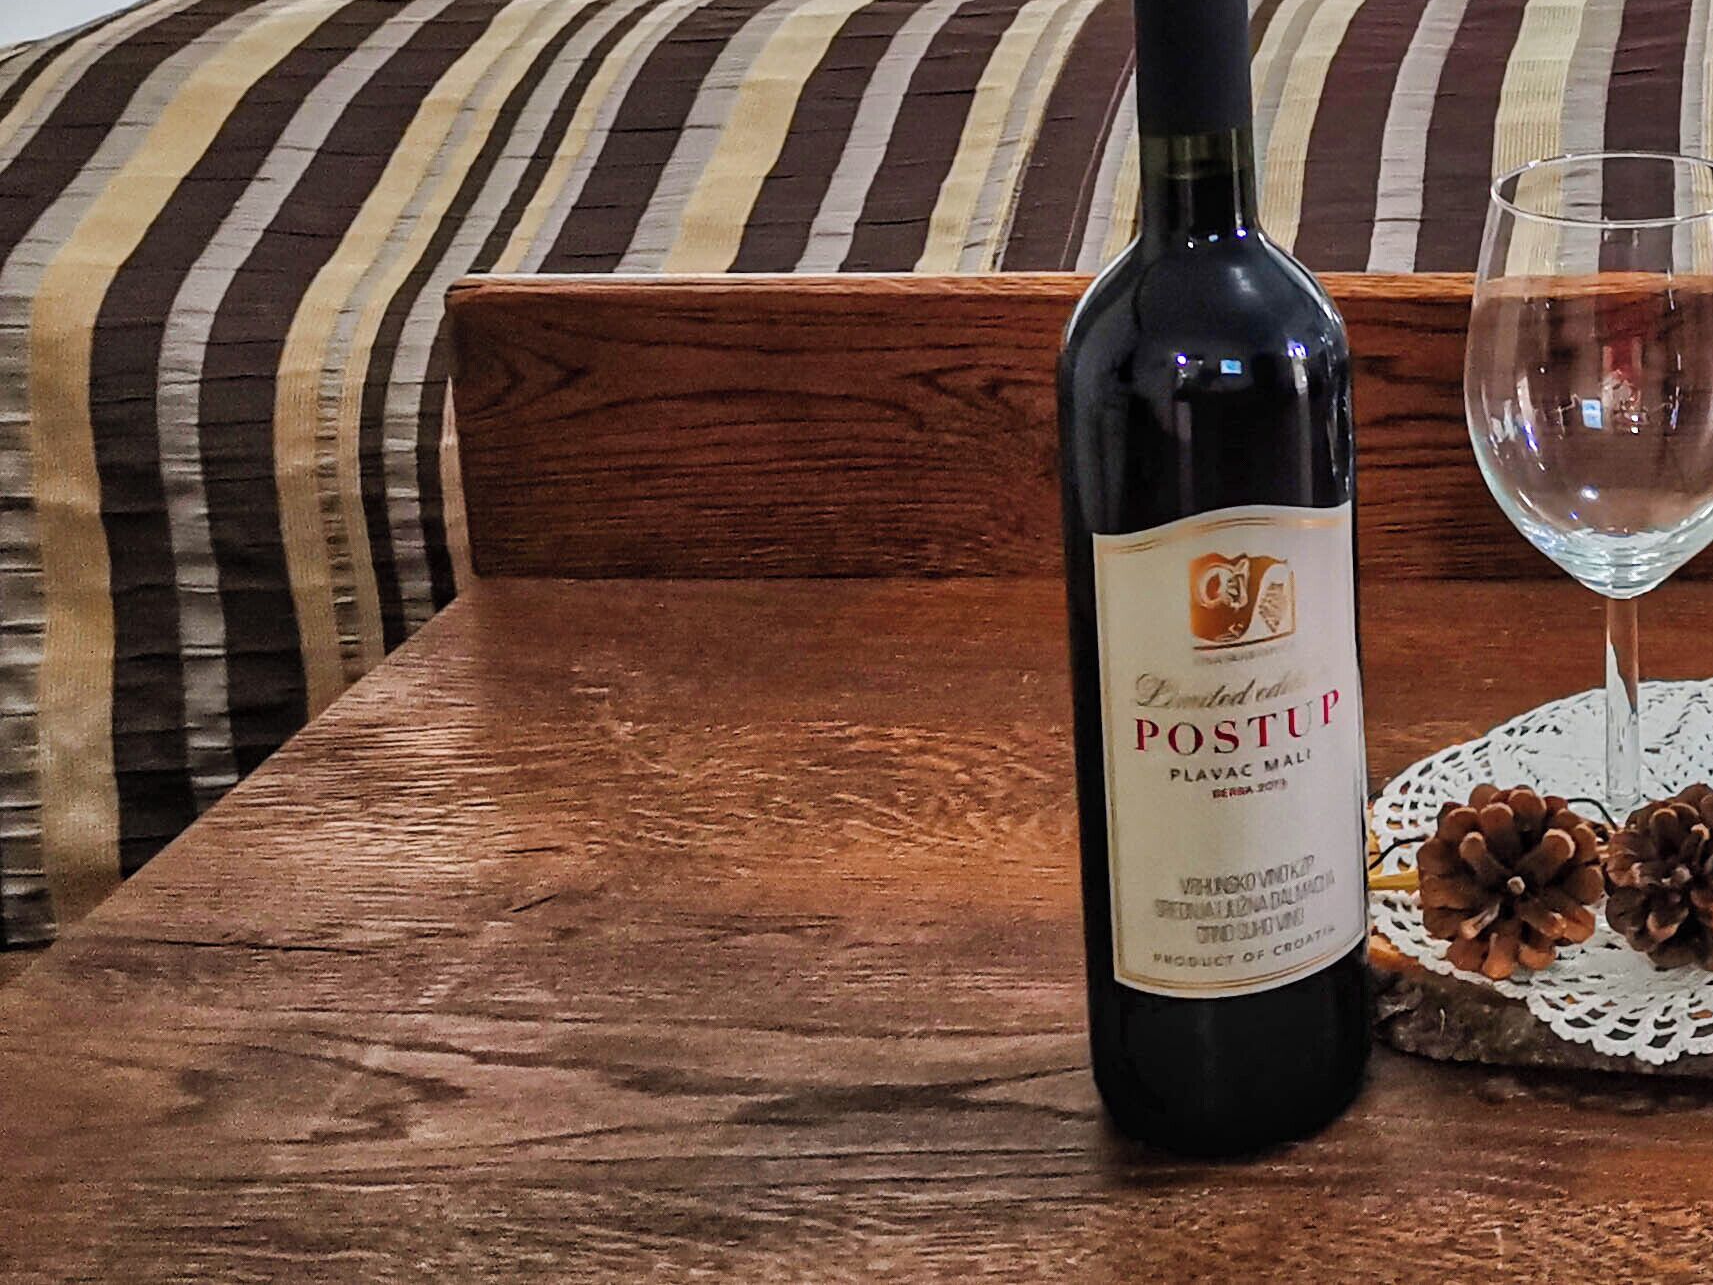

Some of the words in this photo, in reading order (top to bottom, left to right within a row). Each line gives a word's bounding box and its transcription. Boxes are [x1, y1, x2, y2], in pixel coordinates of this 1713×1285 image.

[1135, 689, 1340, 756] POSTUP
[1170, 764, 1252, 783] PLAVAC
[1264, 748, 1311, 771] MALI
[1153, 953, 1235, 968] PRODUCT
[1243, 949, 1266, 963] OF
[1273, 925, 1336, 956] CROATIA
